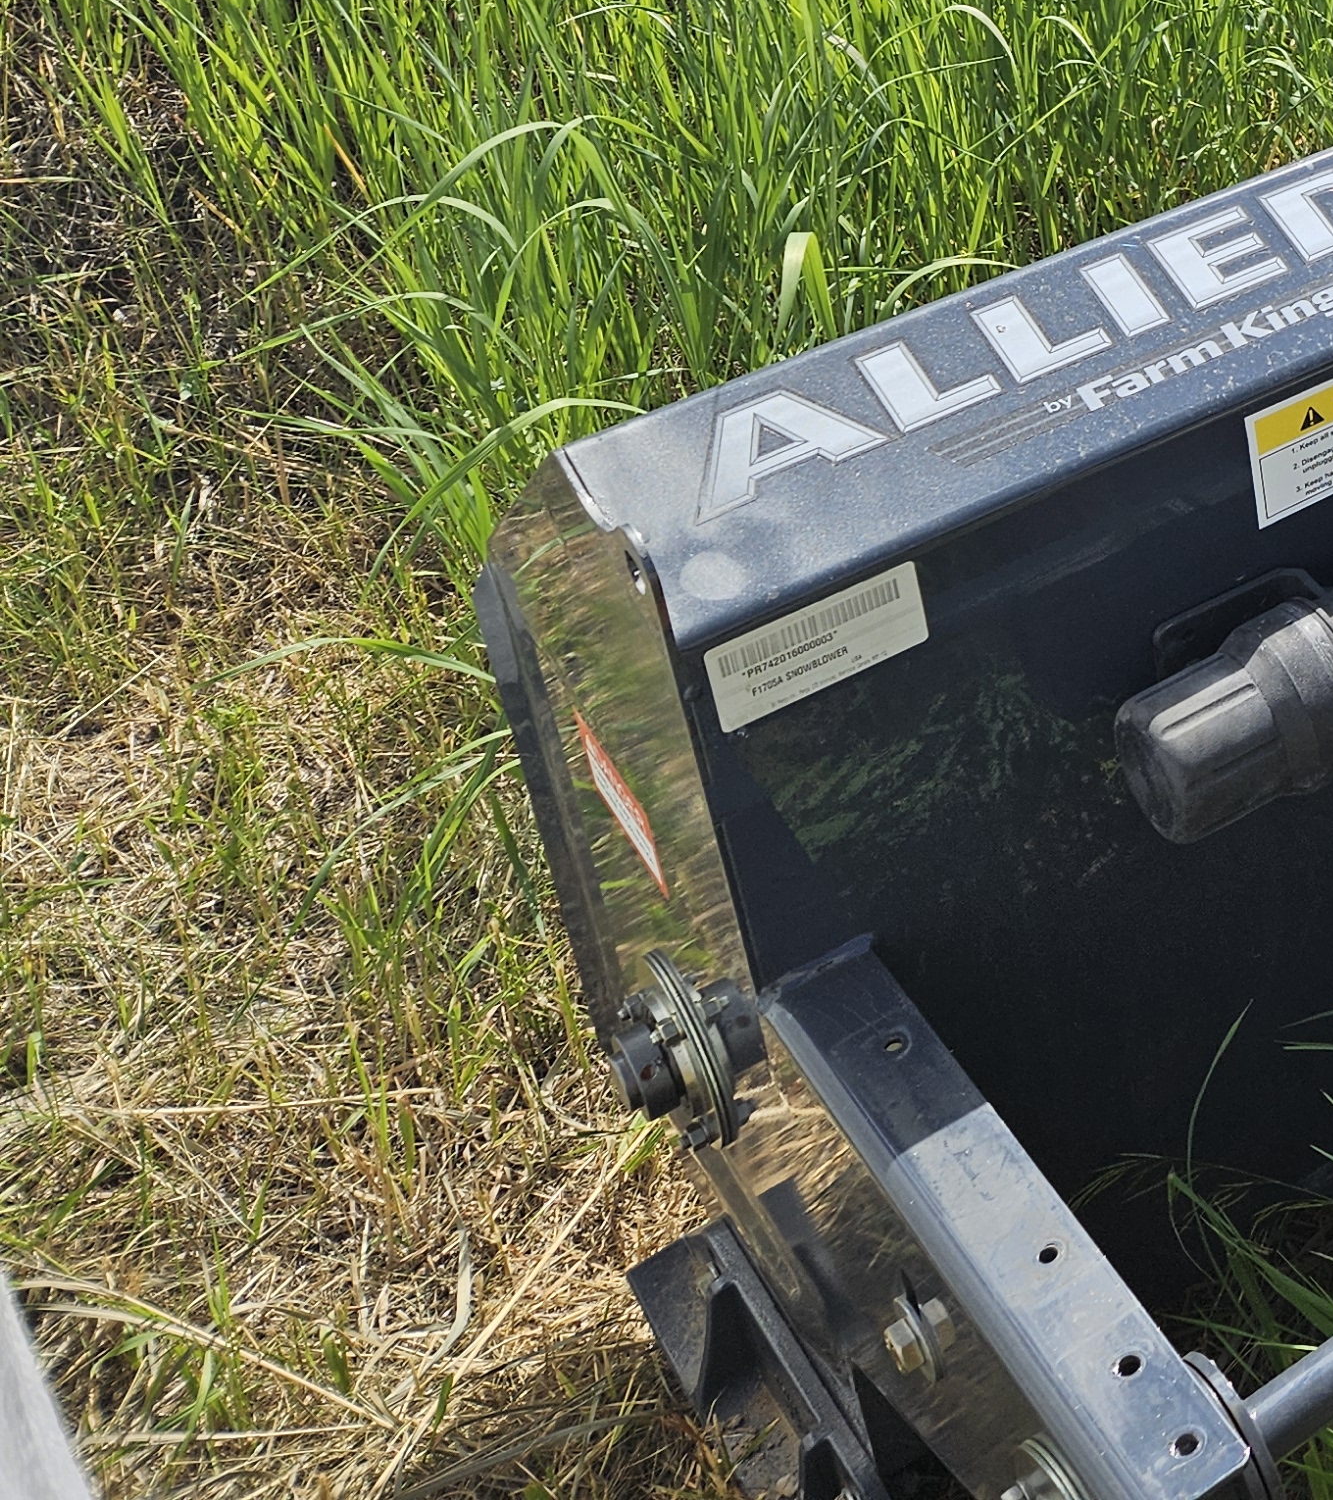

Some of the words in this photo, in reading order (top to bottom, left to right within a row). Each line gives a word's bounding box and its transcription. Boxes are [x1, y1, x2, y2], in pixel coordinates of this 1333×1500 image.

[1043, 395, 1072, 414] by
[1299, 437, 1318, 451] Keep
[1320, 432, 1329, 442] all
[1304, 475, 1323, 489] Keep
[1305, 480, 1332, 496] moving
[786, 646, 848, 681] SNOWBLOWER
